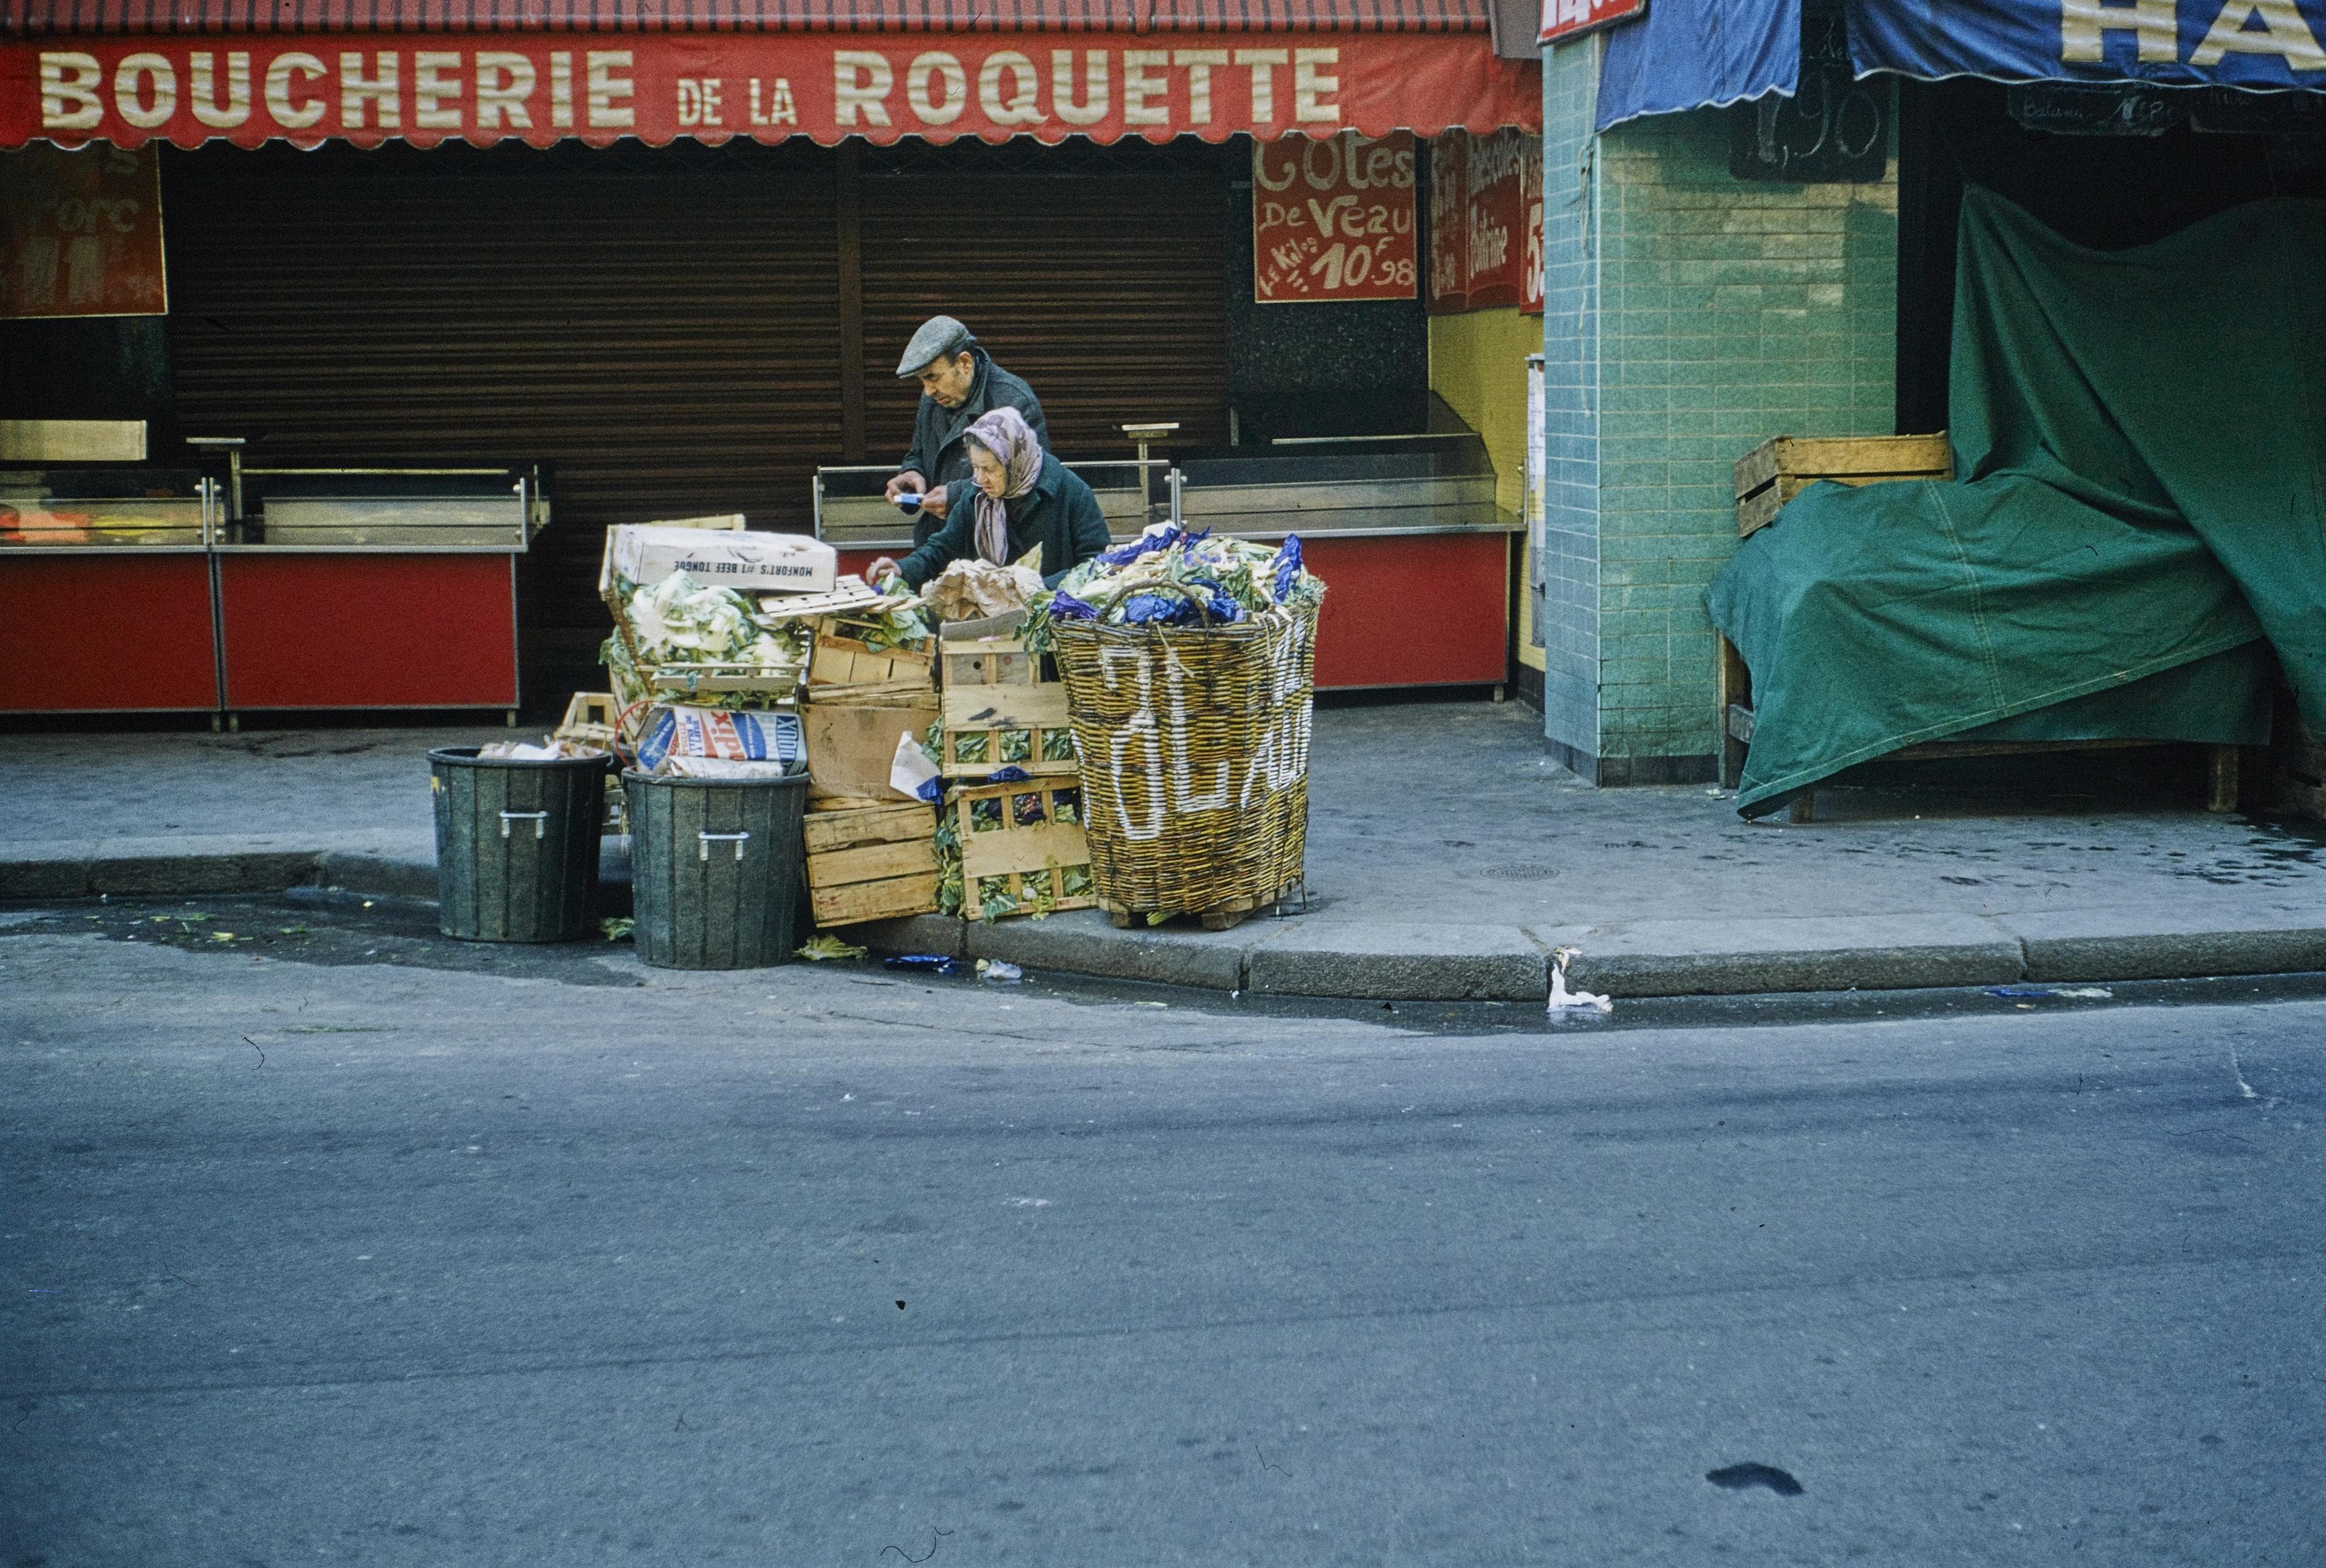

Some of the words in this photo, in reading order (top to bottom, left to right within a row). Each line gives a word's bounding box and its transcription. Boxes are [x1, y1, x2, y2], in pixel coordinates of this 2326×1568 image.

[2062, 0, 2326, 71] HA
[40, 50, 636, 128] BOUCHERIE
[678, 78, 722, 126] DE
[749, 78, 797, 126] LA
[834, 47, 1341, 128] ROQUETTE
[1259, 202, 1307, 232] De
[1307, 194, 1412, 238] Veau
[674, 560, 710, 572] TONGUE
[715, 562, 737, 573] BEEF
[741, 563, 754, 574] #1
[761, 564, 813, 577] MONFORT'S
[776, 718, 798, 758] DOUX
